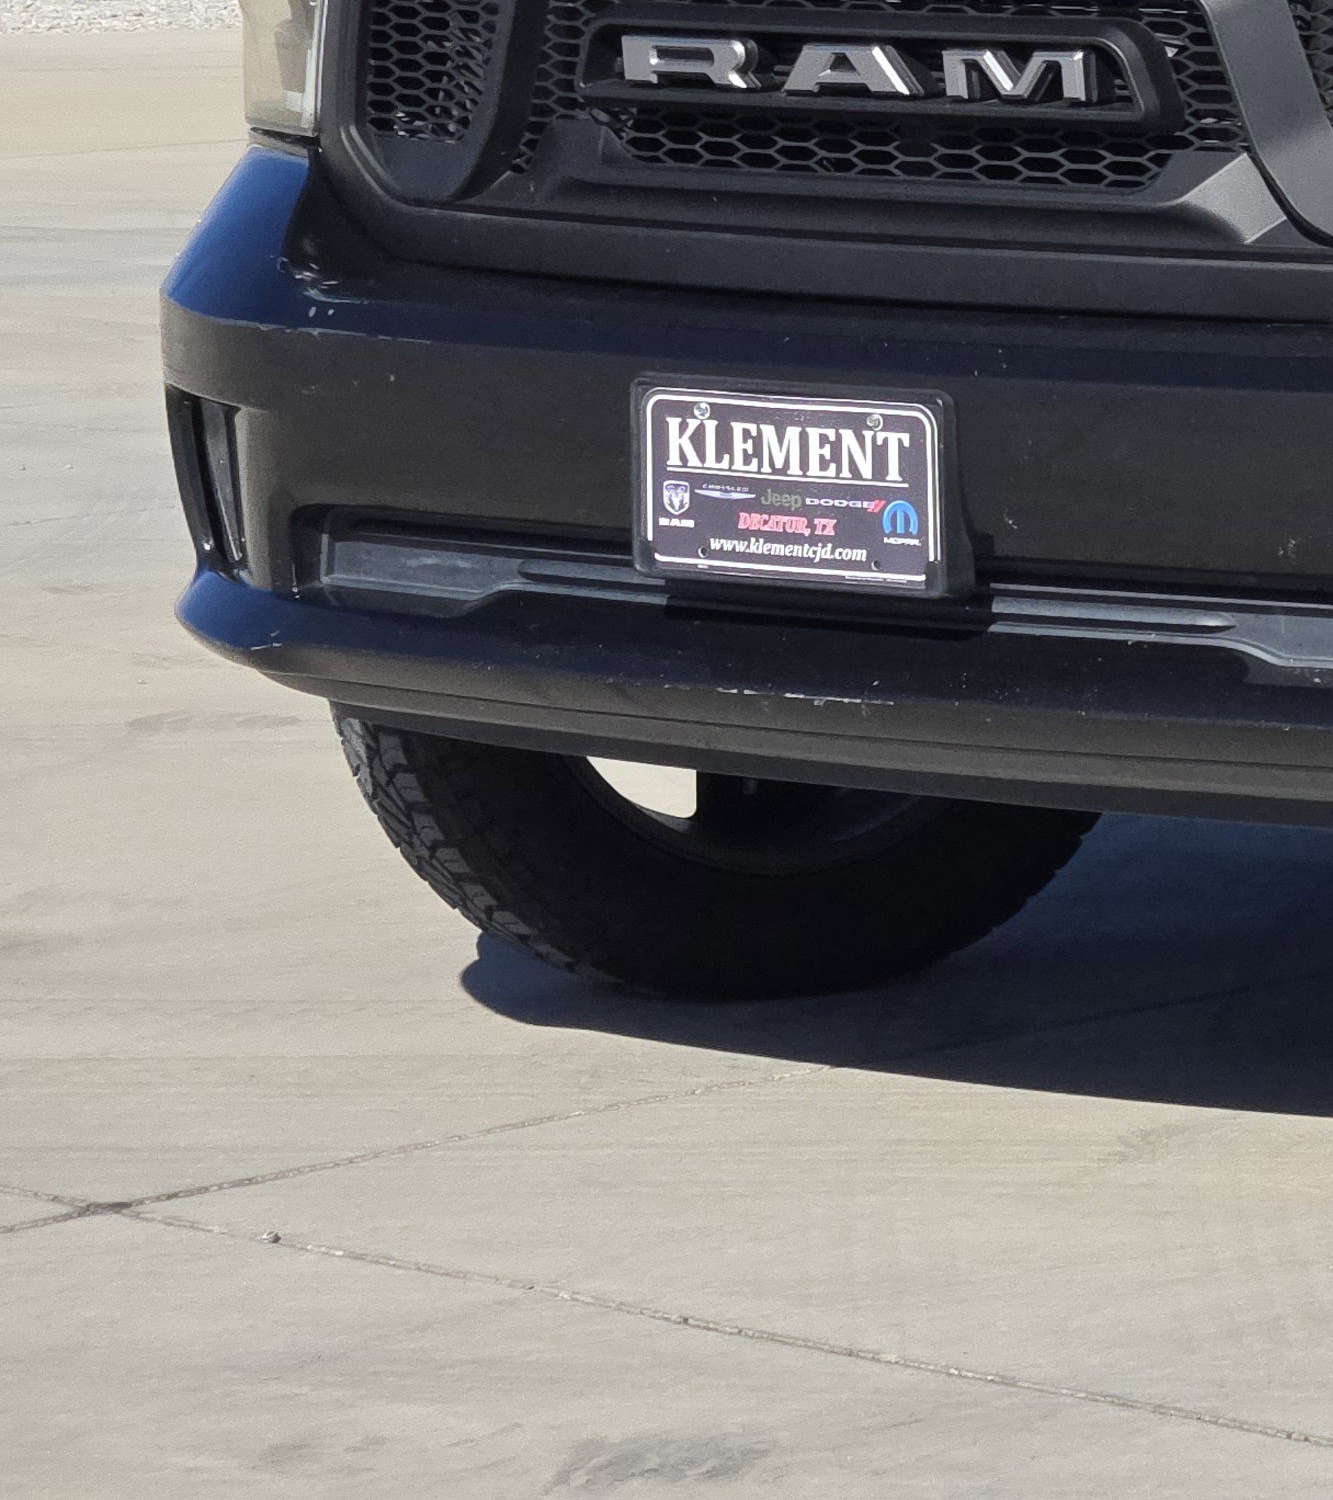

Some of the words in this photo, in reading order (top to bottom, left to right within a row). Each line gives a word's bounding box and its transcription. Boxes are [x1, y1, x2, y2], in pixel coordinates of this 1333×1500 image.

[620, 33, 1098, 102] RAM
[665, 417, 910, 482] KLEMENT
[760, 488, 803, 511] Jeep
[805, 497, 875, 510] DODGE
[738, 512, 811, 536] DECATUR,
[814, 518, 837, 536] TX
[709, 535, 868, 562] www.klementcjd.com
